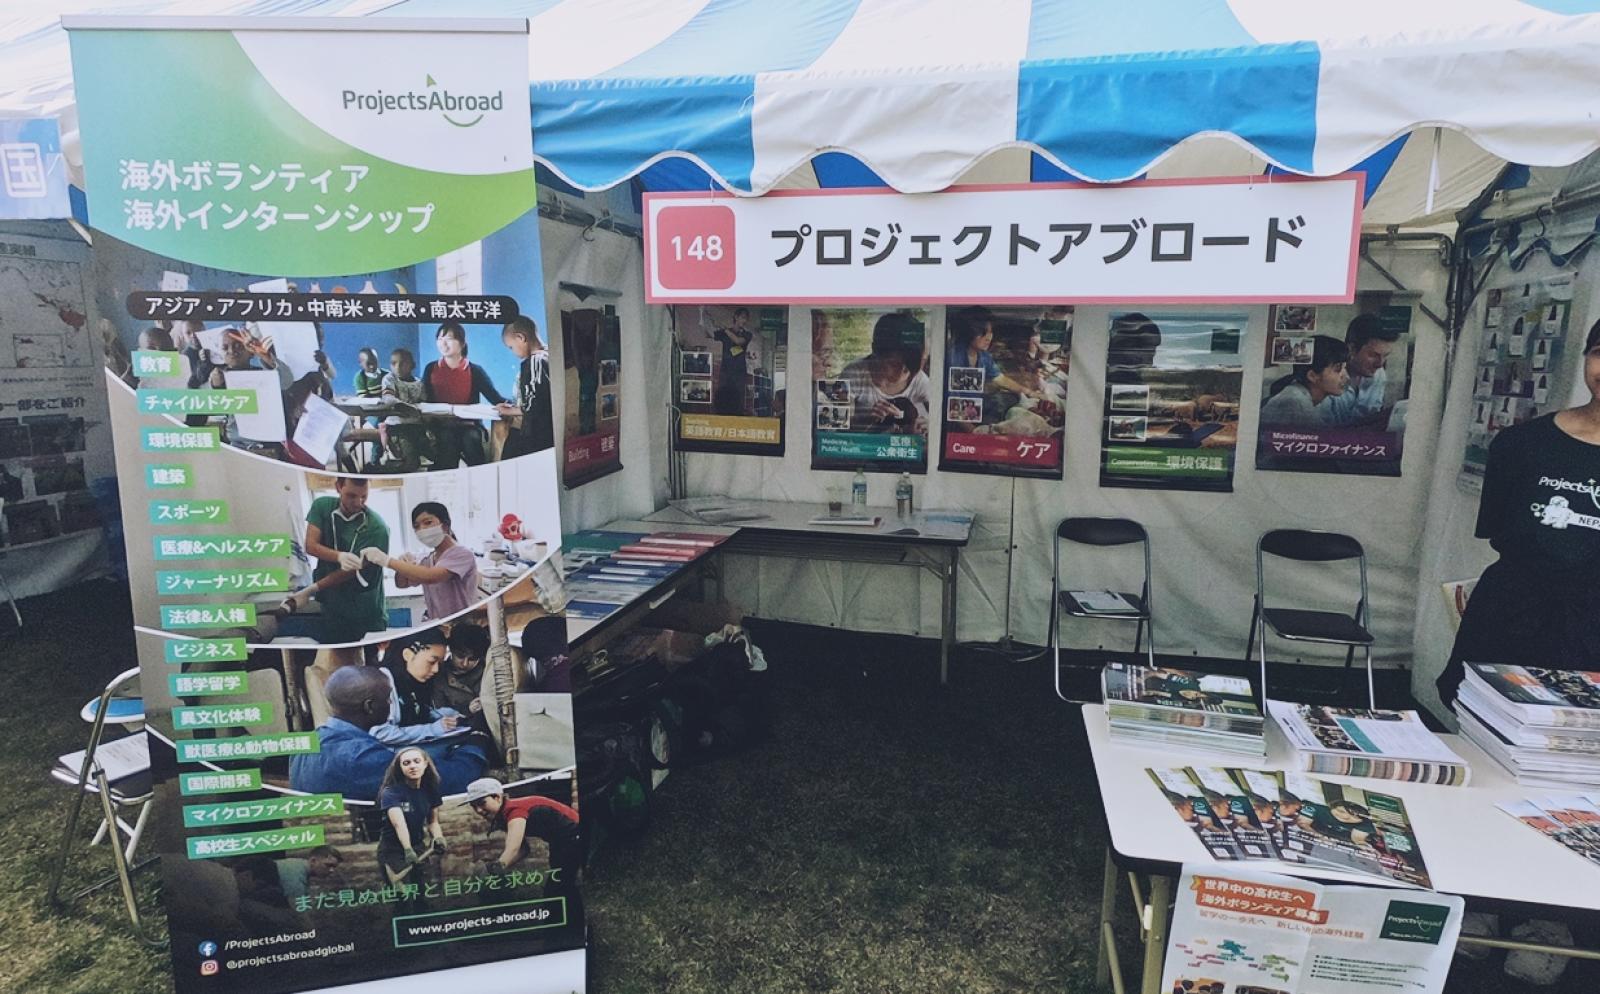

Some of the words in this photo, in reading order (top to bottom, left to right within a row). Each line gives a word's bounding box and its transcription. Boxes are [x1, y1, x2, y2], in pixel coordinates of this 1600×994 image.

[342, 89, 503, 115] ProjectsAbroad
[119, 159, 370, 193] 海外ボランティア
[124, 200, 436, 234] 海外インターンシップ
[670, 235, 724, 261] 148
[770, 214, 1307, 270] プロジェクトアブロード
[140, 356, 172, 373] 教育
[0, 397, 85, 411] 一部をご紹介
[145, 394, 250, 411] チャイルドケア
[148, 432, 214, 449] 環境保護
[952, 442, 977, 454] Care
[1272, 441, 1386, 457] マイクロファイナンス
[1016, 441, 1052, 459] ケア
[1166, 455, 1223, 471] 環境保護
[157, 504, 221, 520] スポーツ
[161, 538, 284, 556] 医療&ヘルスケア
[165, 573, 279, 590] ジャーナリズム
[169, 608, 248, 625] 法律&人権
[173, 642, 237, 658] ビジネス
[175, 675, 241, 693] 語学留学
[180, 707, 262, 726] 異文化体験
[184, 736, 312, 759] 獣医療&動物保護
[187, 773, 252, 791] 国際開発
[192, 799, 336, 821] マイクロファイナンス
[195, 830, 316, 854] 高校生スペシャル
[295, 868, 562, 912] まだ見ぬ世界と自分を求めて
[1204, 878, 1306, 905] 世界中の高校生へ
[408, 909, 550, 935] www.projects-abroad.jp
[224, 929, 316, 951] /ProjectsAbroad
[226, 942, 355, 971] @projectsabroadglobal
